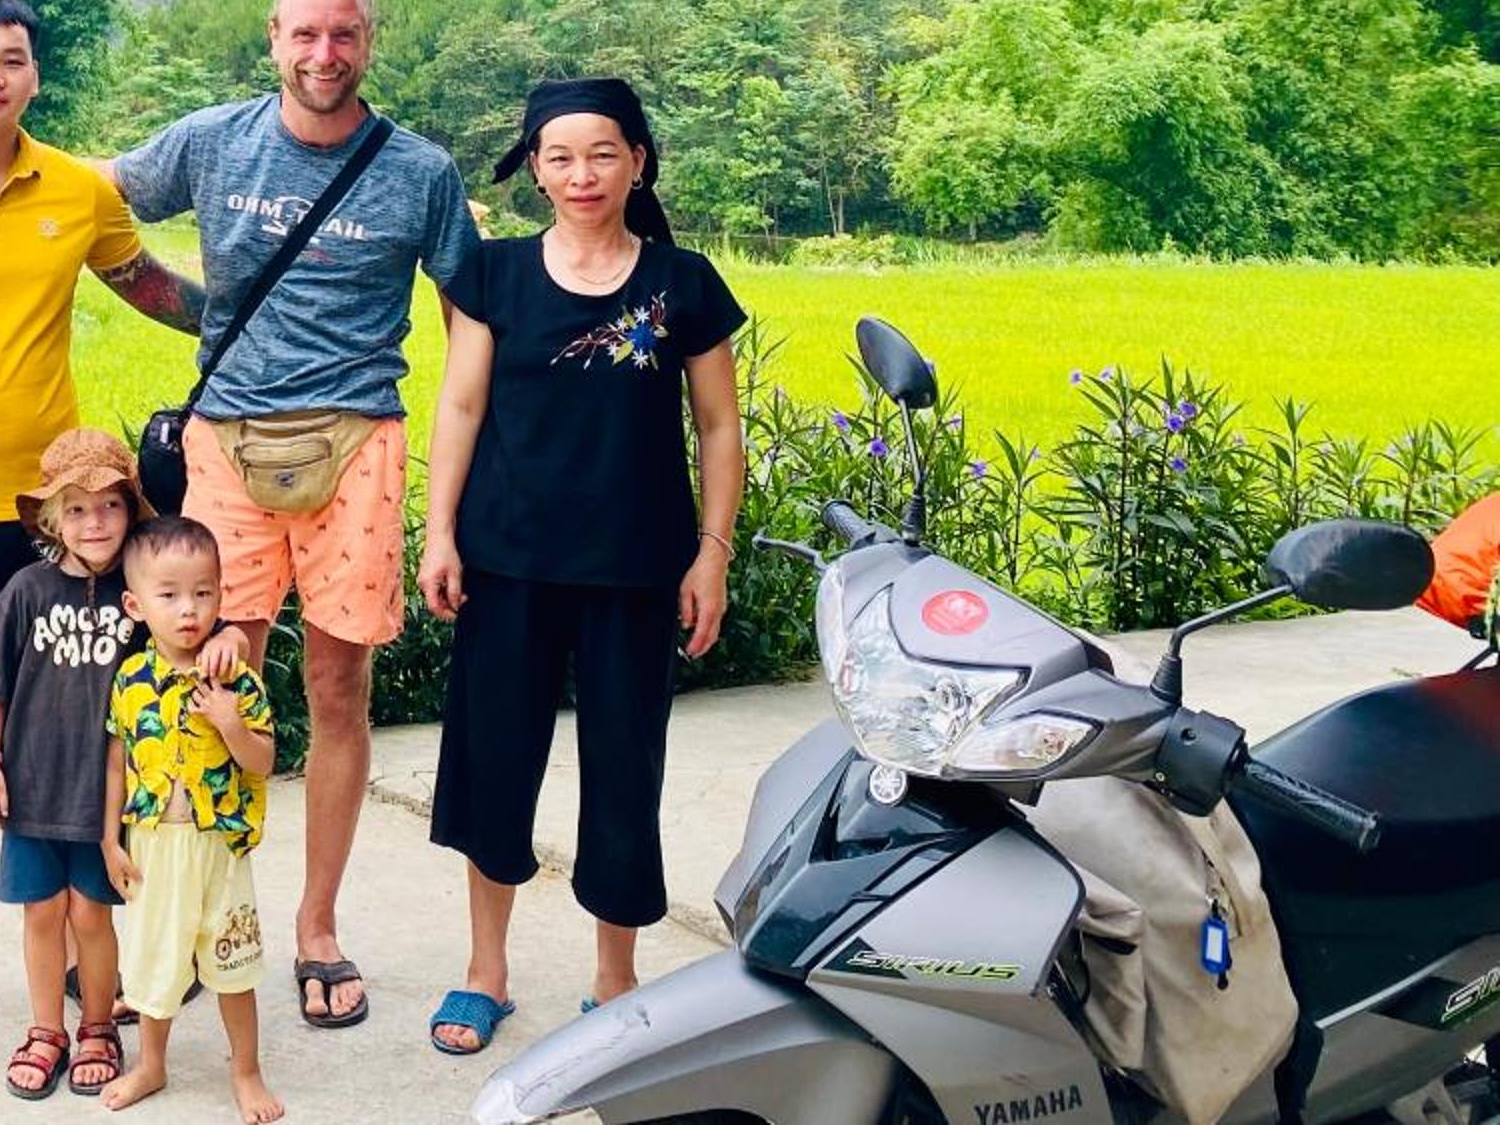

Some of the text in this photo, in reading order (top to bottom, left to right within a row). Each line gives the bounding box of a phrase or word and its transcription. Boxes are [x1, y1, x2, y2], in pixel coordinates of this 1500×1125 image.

[53, 633, 118, 668] MIO
[846, 949, 1024, 981] SIRIUS
[973, 1084, 1083, 1125] YAMAHA
